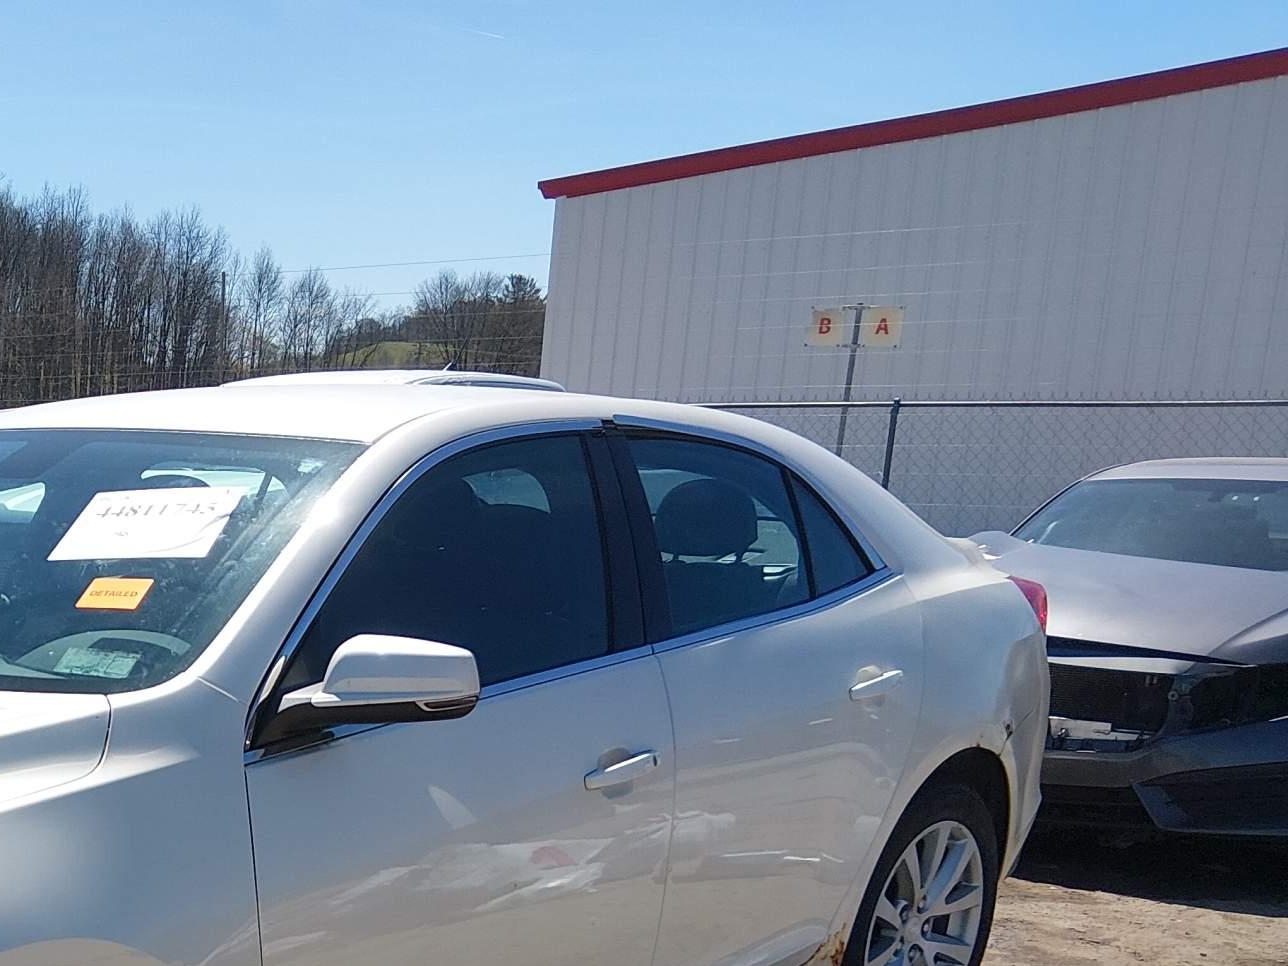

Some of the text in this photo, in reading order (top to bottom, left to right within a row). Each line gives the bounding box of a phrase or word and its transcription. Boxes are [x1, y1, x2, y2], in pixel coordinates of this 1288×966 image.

[818, 317, 832, 335] B
[874, 317, 889, 335] A
[95, 501, 219, 519] 44811745
[88, 589, 139, 598] DETAILED
